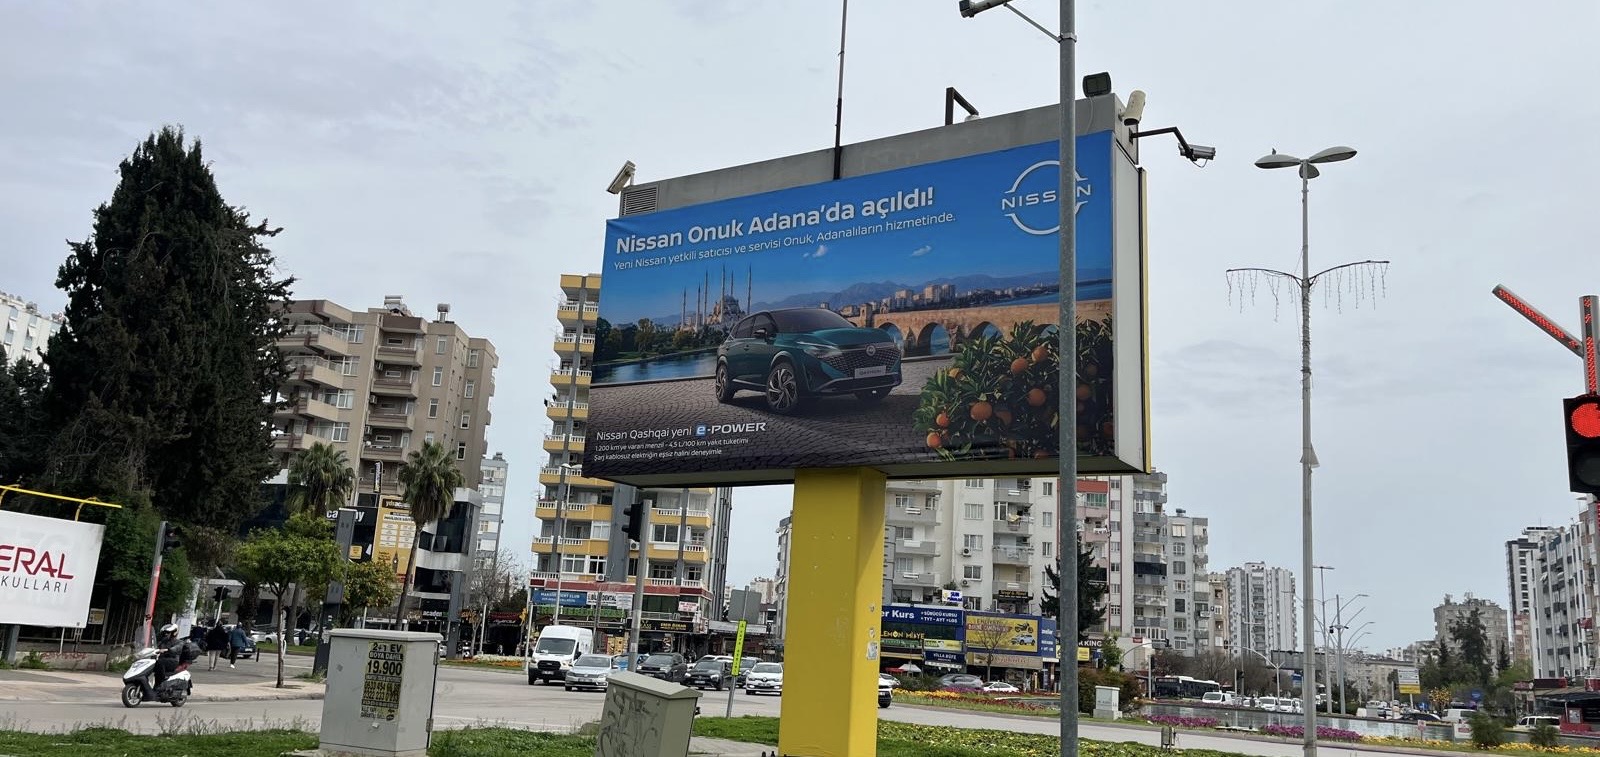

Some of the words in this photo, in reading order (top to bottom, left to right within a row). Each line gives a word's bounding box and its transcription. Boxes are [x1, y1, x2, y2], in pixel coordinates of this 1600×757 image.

[1001, 184, 1091, 210] NISSN
[616, 232, 682, 254] Nissan
[688, 219, 743, 243] Onuk
[748, 202, 855, 235] Adana'da
[861, 186, 934, 219] açıldı!
[614, 259, 633, 270] Yeni
[635, 253, 666, 268] Nissan
[668, 251, 696, 266] yetkili
[699, 247, 732, 259] satıcısı
[734, 244, 747, 254] ve
[748, 239, 781, 252] servisi
[783, 233, 814, 246] Onuk,
[816, 223, 883, 242] Adanalıların
[885, 212, 956, 232] hizmetinde.
[596, 431, 627, 441] Nissan
[629, 428, 670, 439] Qashqai
[671, 425, 692, 439] yeni
[696, 422, 767, 435] e-POWER
[1, 575, 68, 593] KULLARI
[892, 610, 914, 619] Kurs
[390, 643, 402, 653] EV
[367, 660, 403, 676] 19.900
